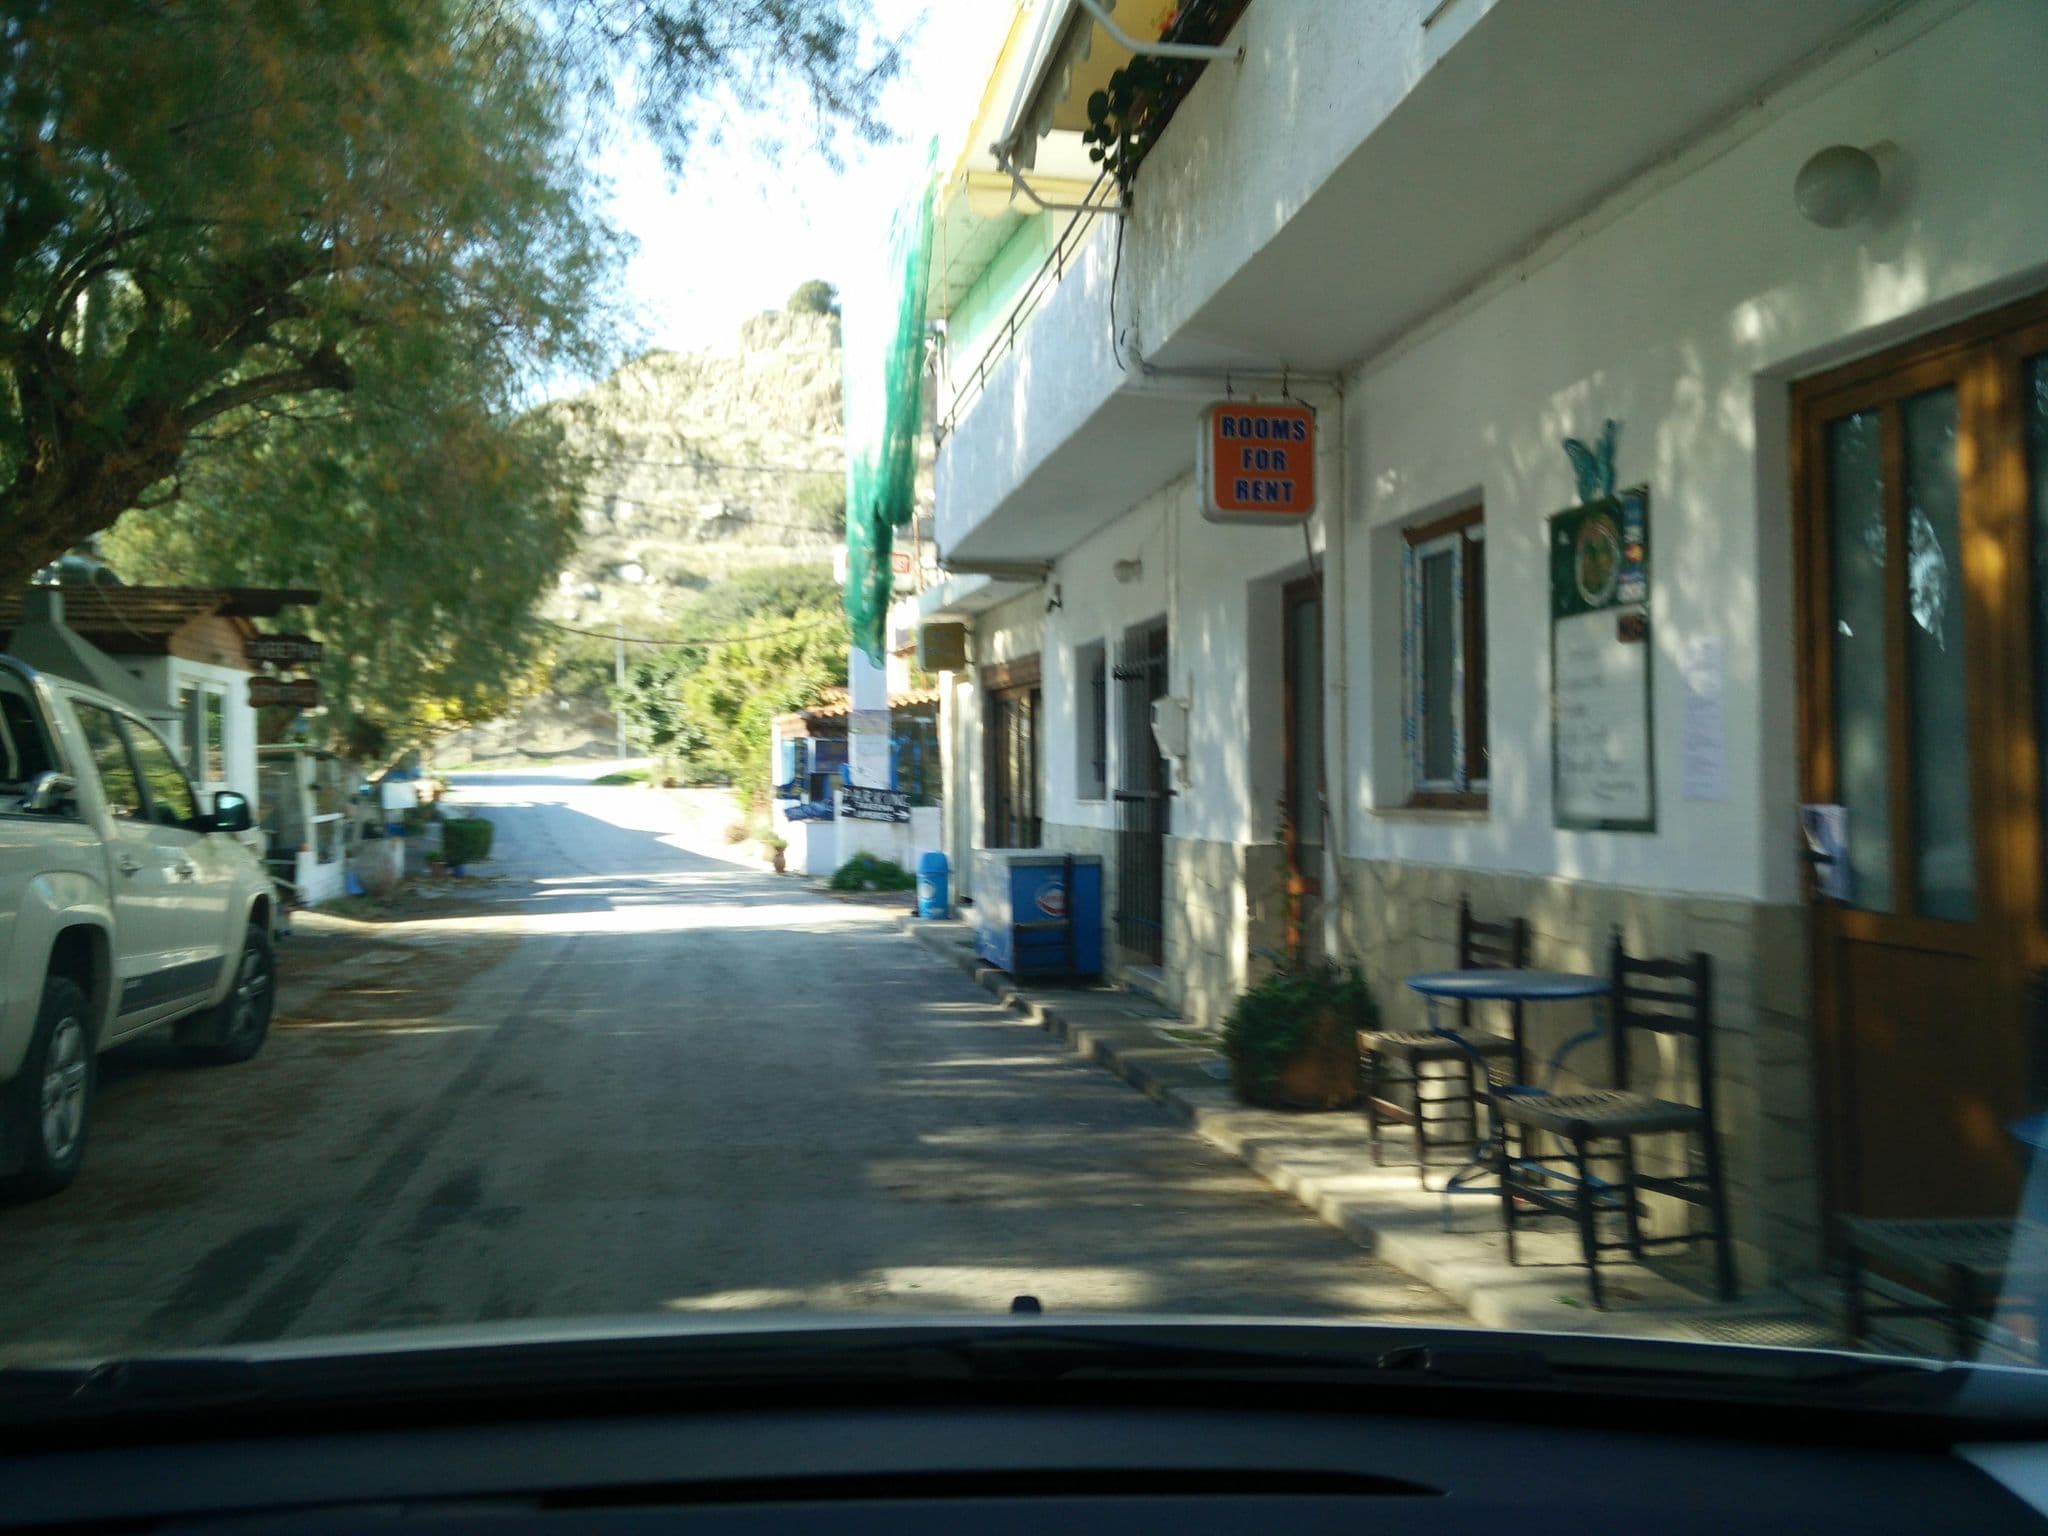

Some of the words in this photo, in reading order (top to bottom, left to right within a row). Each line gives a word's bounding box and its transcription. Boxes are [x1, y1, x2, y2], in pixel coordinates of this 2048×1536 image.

[1221, 415, 1306, 442] ROOMS
[1242, 448, 1286, 470] FOR
[1235, 479, 1295, 502] RENT
